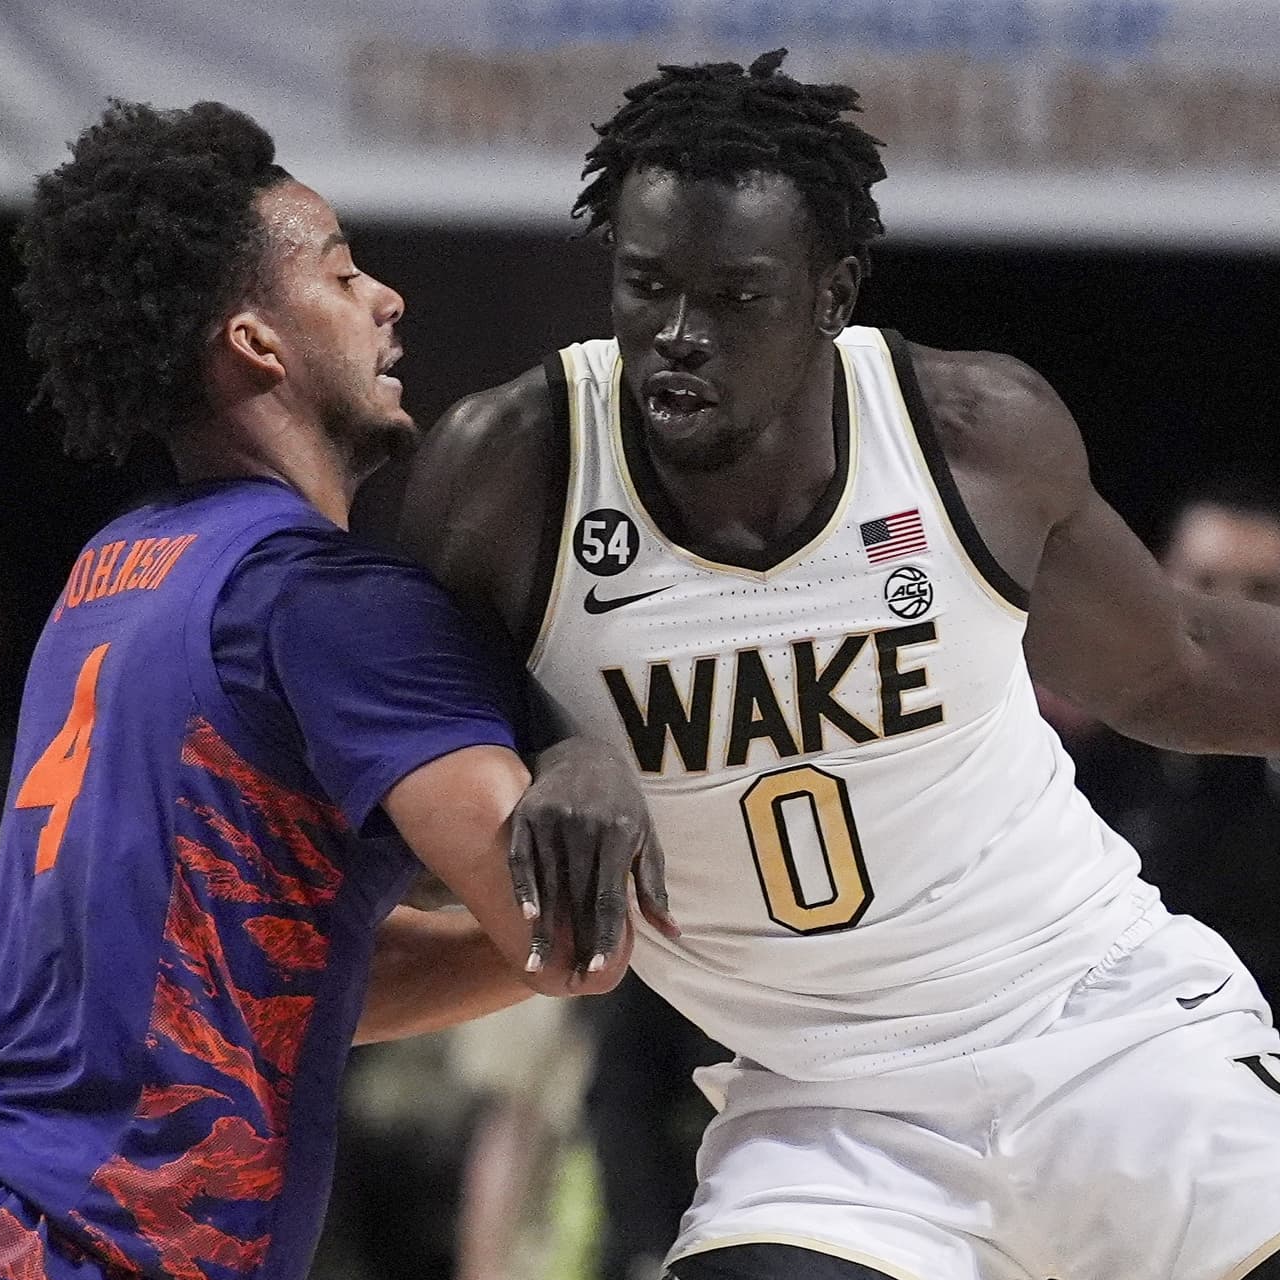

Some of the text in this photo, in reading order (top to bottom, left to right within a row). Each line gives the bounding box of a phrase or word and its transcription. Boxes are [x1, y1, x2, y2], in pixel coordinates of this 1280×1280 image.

[582, 520, 630, 565] 54
[891, 580, 928, 598] ACC
[15, 642, 111, 875] 4
[599, 619, 946, 776] WAKE
[738, 763, 875, 936] 0
